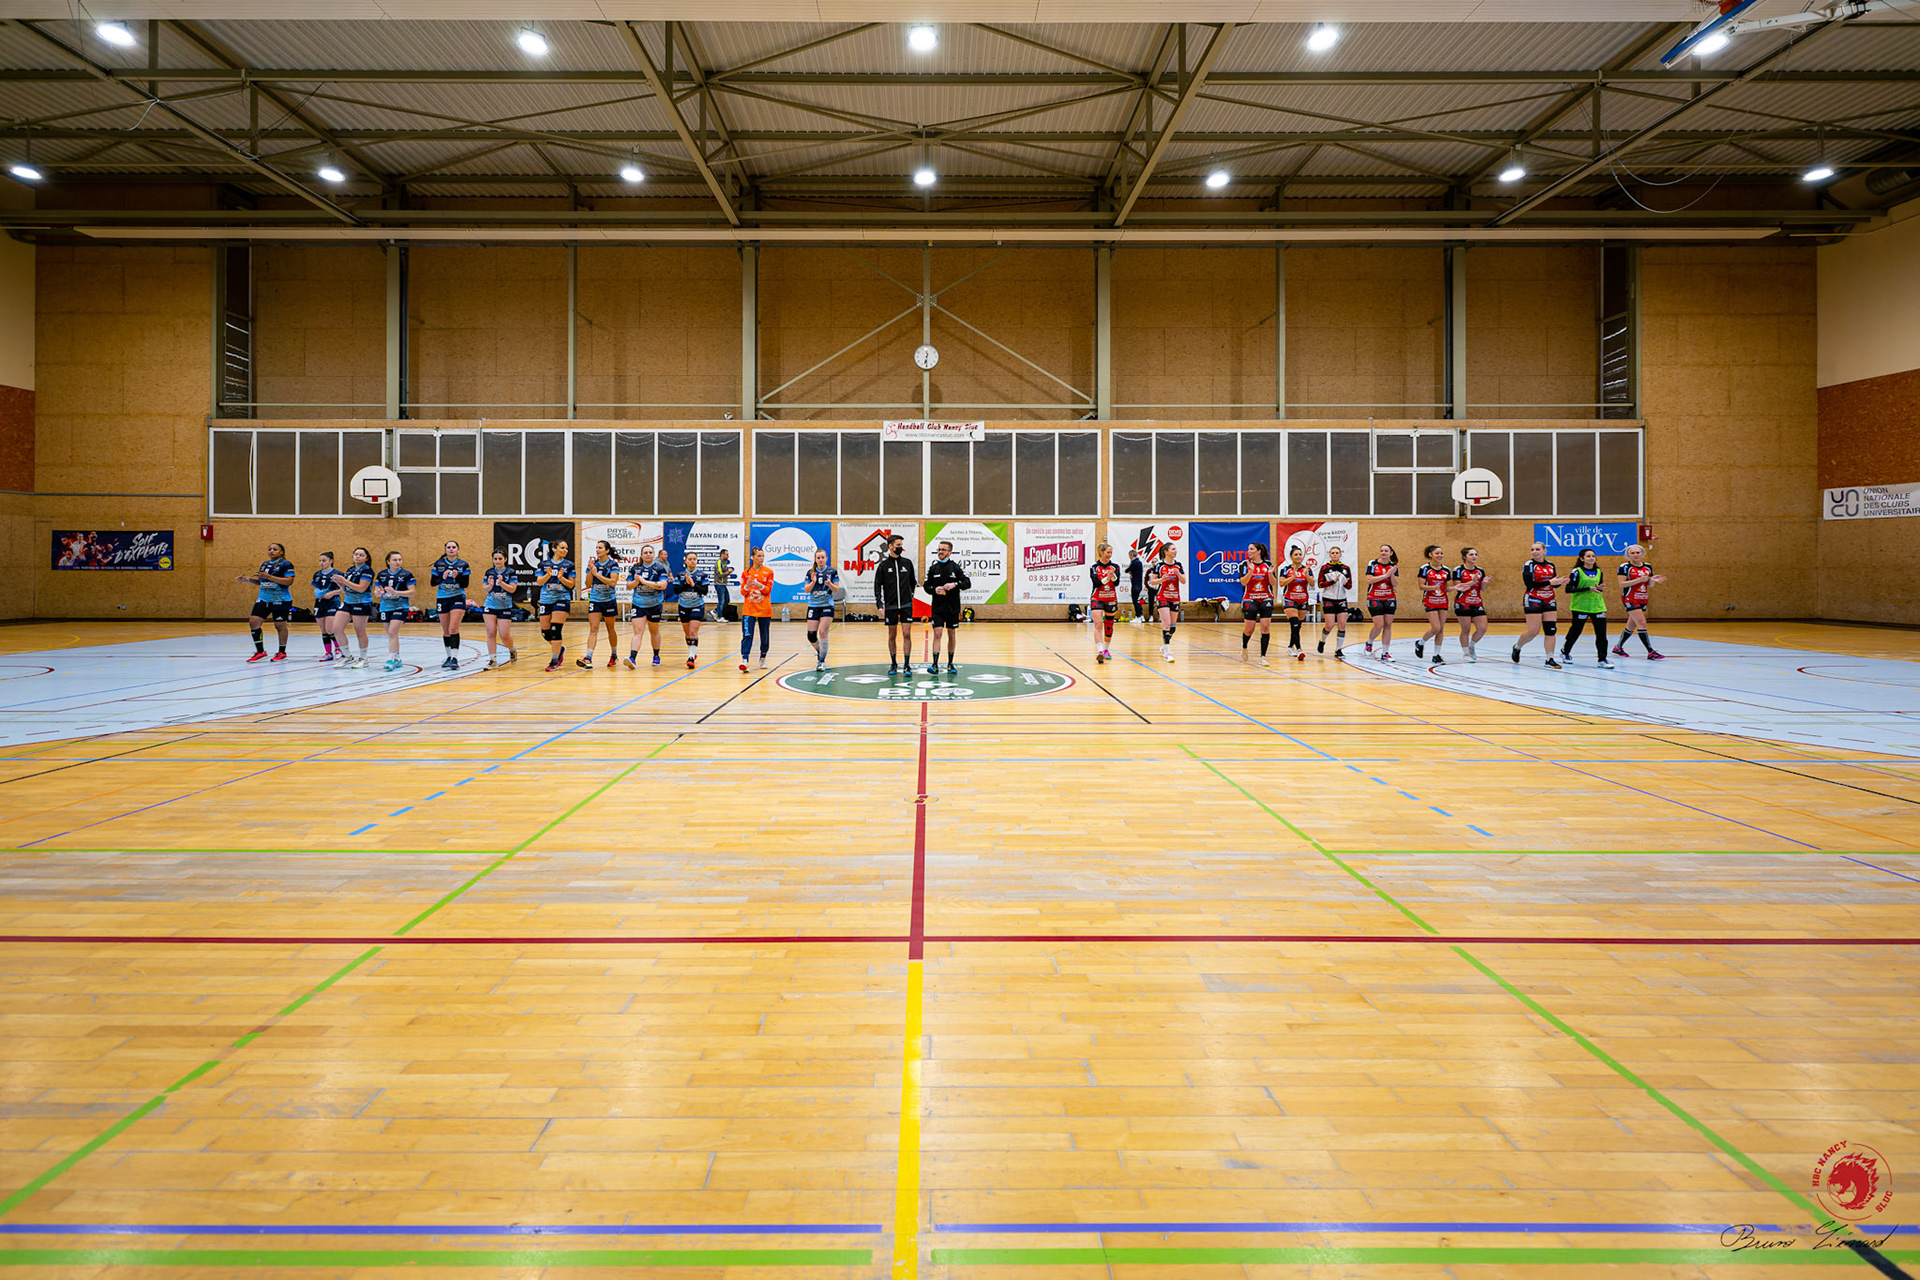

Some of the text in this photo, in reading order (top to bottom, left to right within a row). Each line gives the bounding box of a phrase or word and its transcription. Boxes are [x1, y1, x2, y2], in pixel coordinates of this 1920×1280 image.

[944, 424, 961, 432] Nancy
[1863, 493, 1911, 501] NATIONALE
[1543, 525, 1628, 552] Nancy
[765, 544, 814, 554] Guy Hoquet
[1029, 547, 1051, 564] Cave
[1057, 543, 1079, 561] Léon
